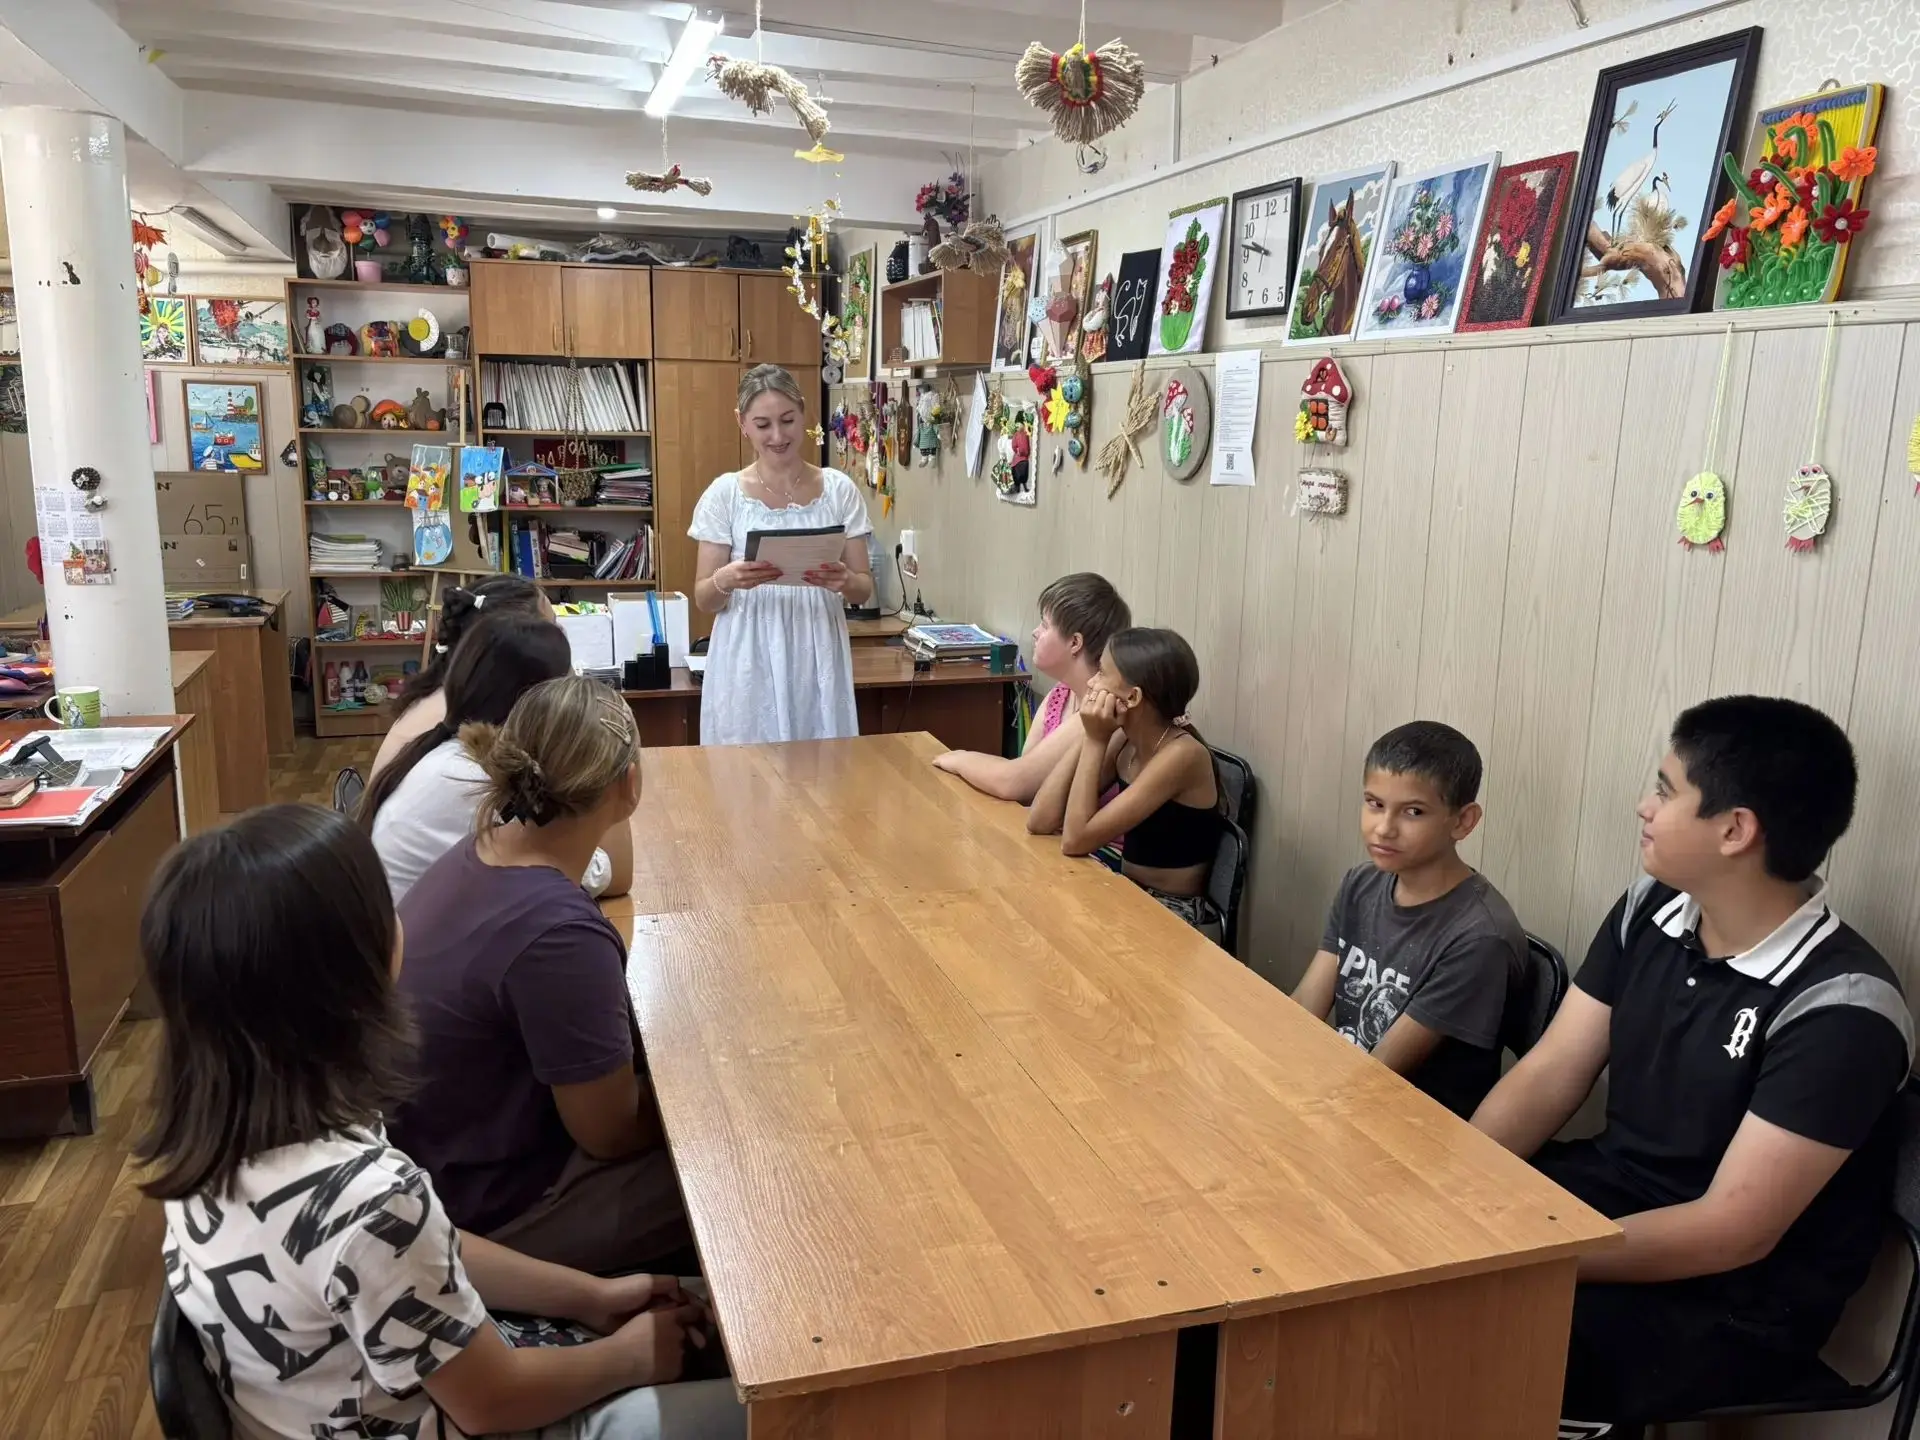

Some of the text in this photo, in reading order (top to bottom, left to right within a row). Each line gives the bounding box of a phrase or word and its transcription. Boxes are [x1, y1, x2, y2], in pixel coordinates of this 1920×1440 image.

[1249, 202, 1260, 220] 11
[1264, 198, 1278, 217] 12
[1244, 221, 1255, 240] 10
[1243, 248, 1249, 263] 9
[1241, 271, 1248, 288] 8
[1247, 289, 1254, 305] 7
[1261, 287, 1269, 304] 6
[1277, 286, 1284, 302] 5
